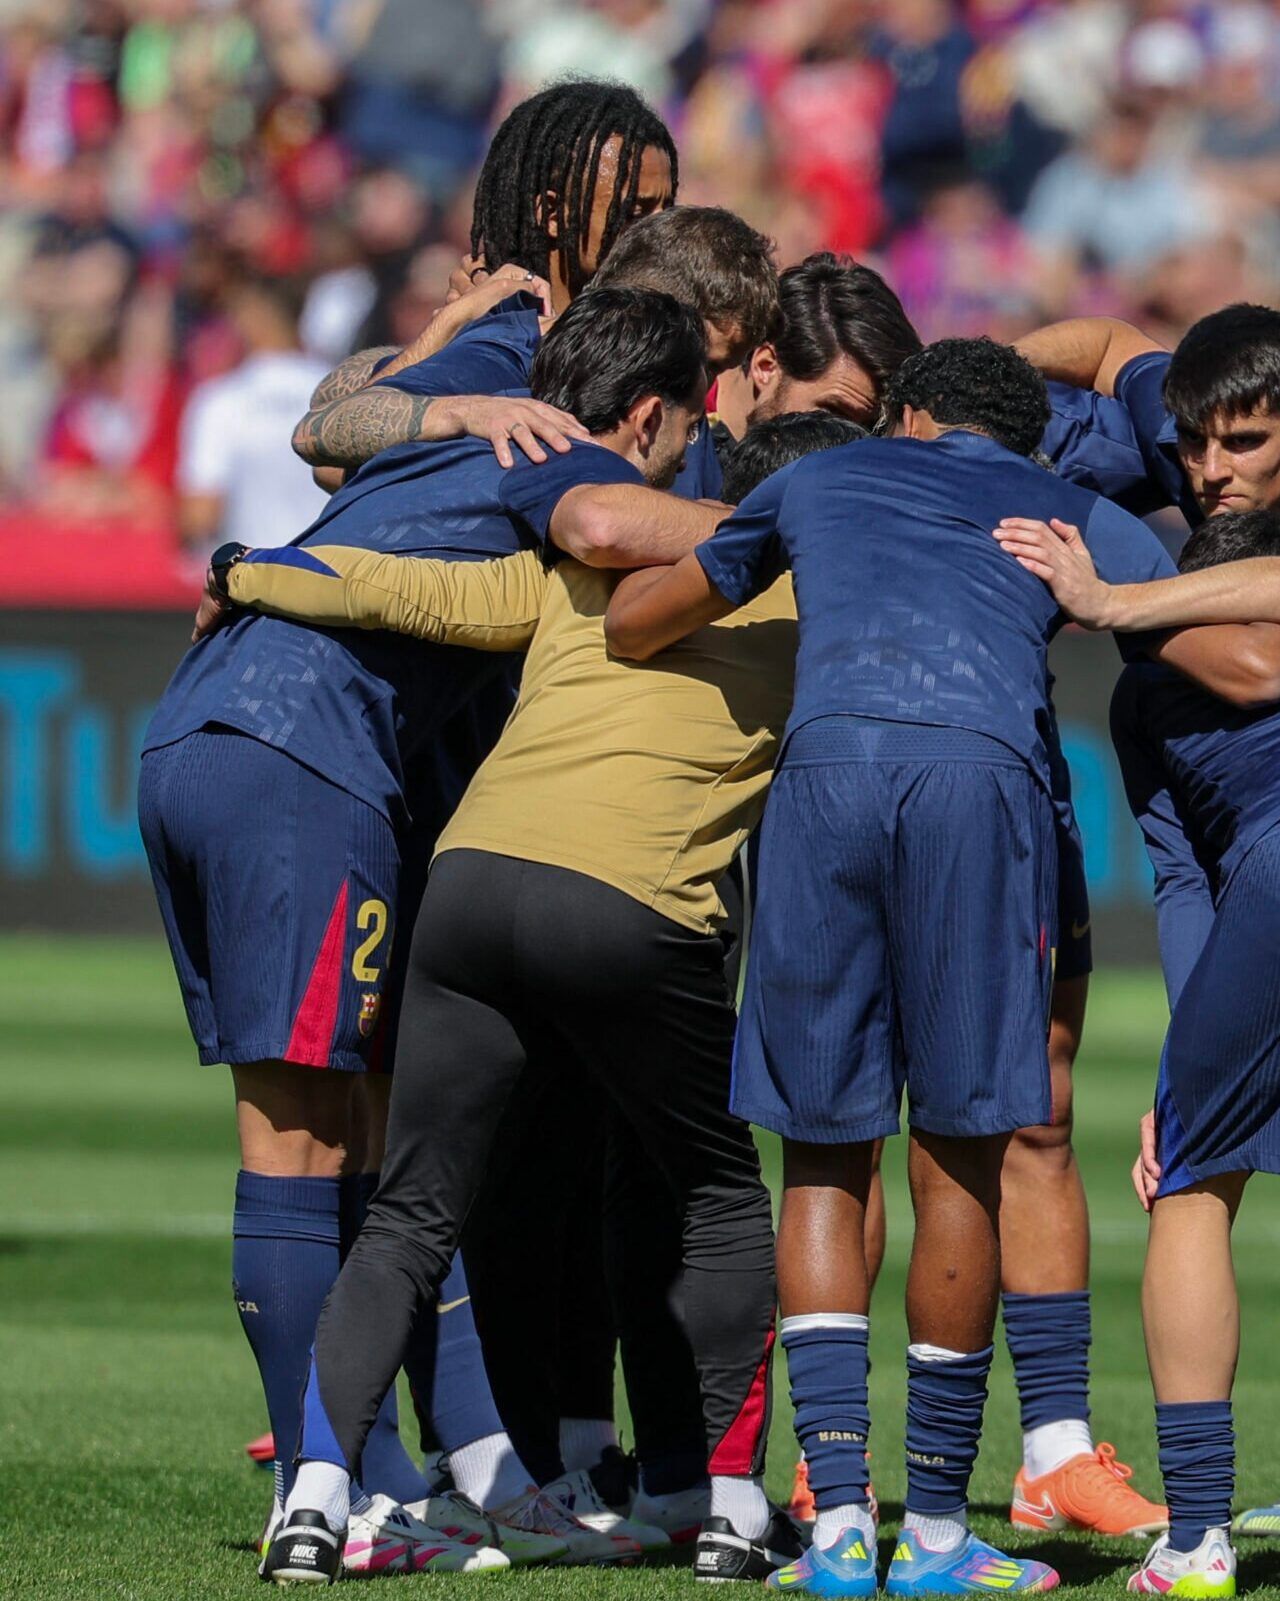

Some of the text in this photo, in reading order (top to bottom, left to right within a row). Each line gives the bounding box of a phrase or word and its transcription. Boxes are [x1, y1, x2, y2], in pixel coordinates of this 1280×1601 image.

[352, 899, 396, 983] 2
[289, 1543, 319, 1560] NIKE
[697, 1551, 720, 1566] NIKE
